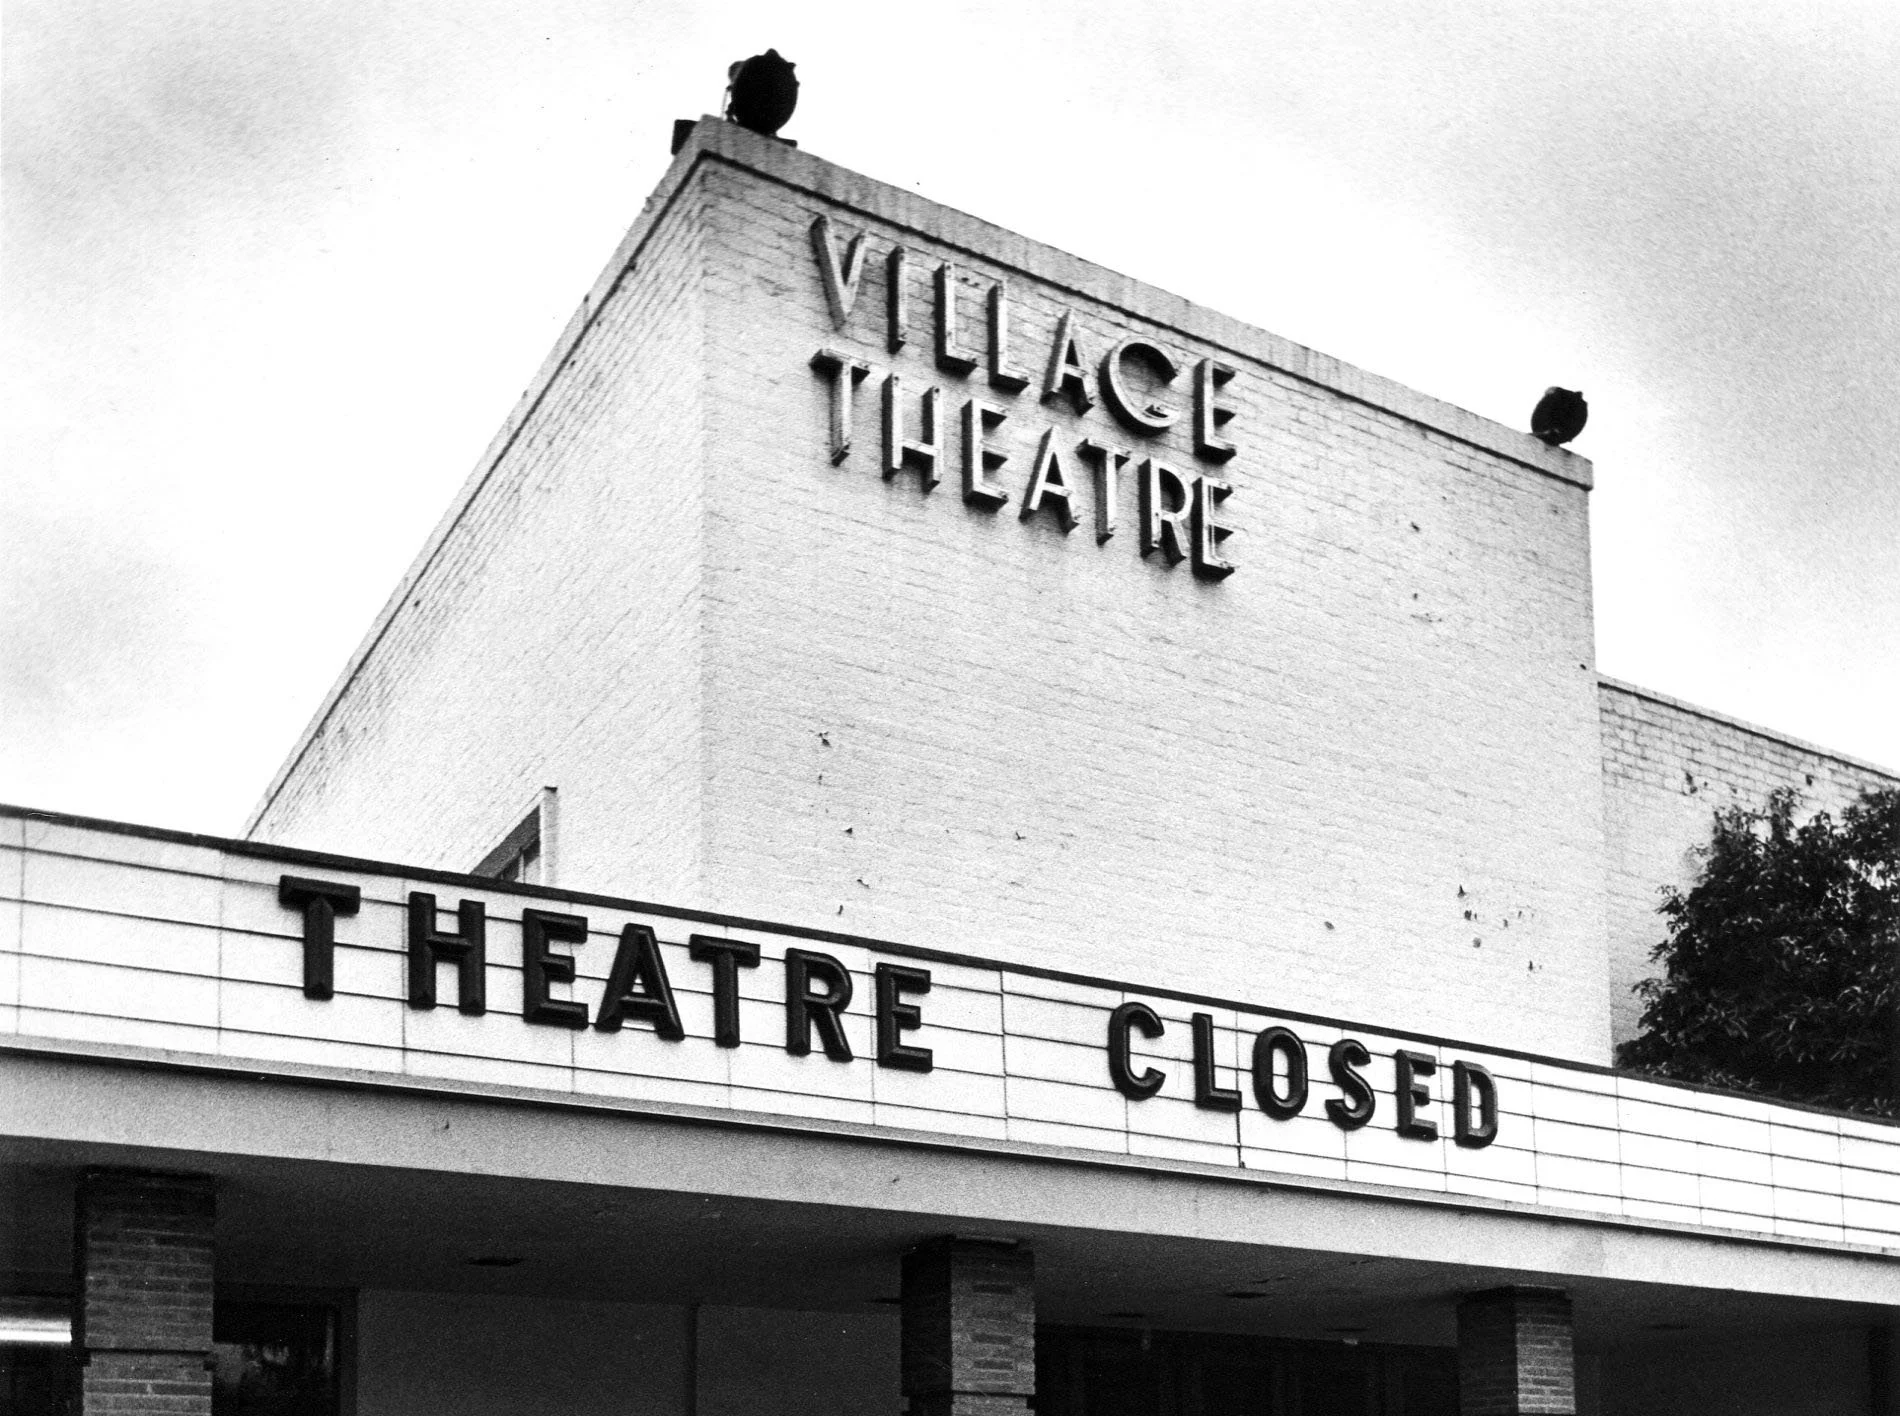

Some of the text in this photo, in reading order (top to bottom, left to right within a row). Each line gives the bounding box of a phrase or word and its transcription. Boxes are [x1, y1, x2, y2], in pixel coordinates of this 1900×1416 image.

[809, 348, 1235, 581] THEATRE
[810, 211, 1236, 465] VILLAGE
[278, 874, 1498, 1149] THEATRE CLOSED
